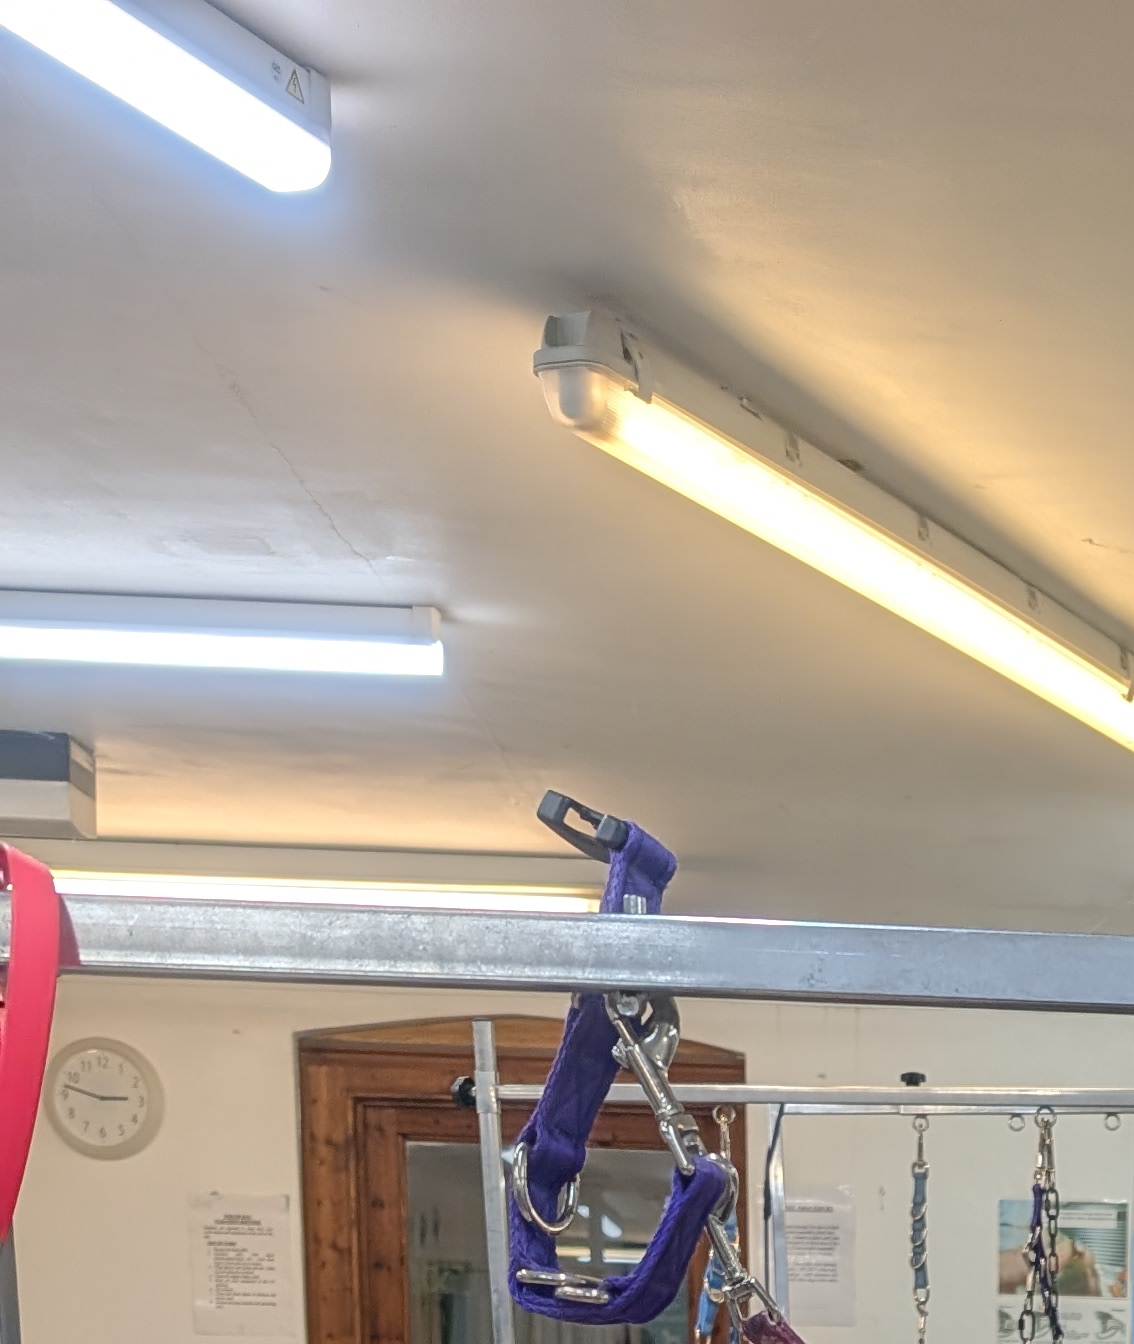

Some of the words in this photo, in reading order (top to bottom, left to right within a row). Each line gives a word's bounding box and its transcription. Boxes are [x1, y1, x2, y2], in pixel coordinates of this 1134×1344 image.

[80, 1060, 92, 1072] 11
[96, 1056, 109, 1069] 12
[67, 1072, 81, 1084] 10
[132, 1077, 140, 1088] 2
[138, 1096, 145, 1107] 3
[68, 1107, 76, 1119] 8
[131, 1114, 139, 1124] 4
[82, 1121, 90, 1132] 7
[118, 1125, 126, 1136] 5
[98, 1127, 107, 1139] 6
